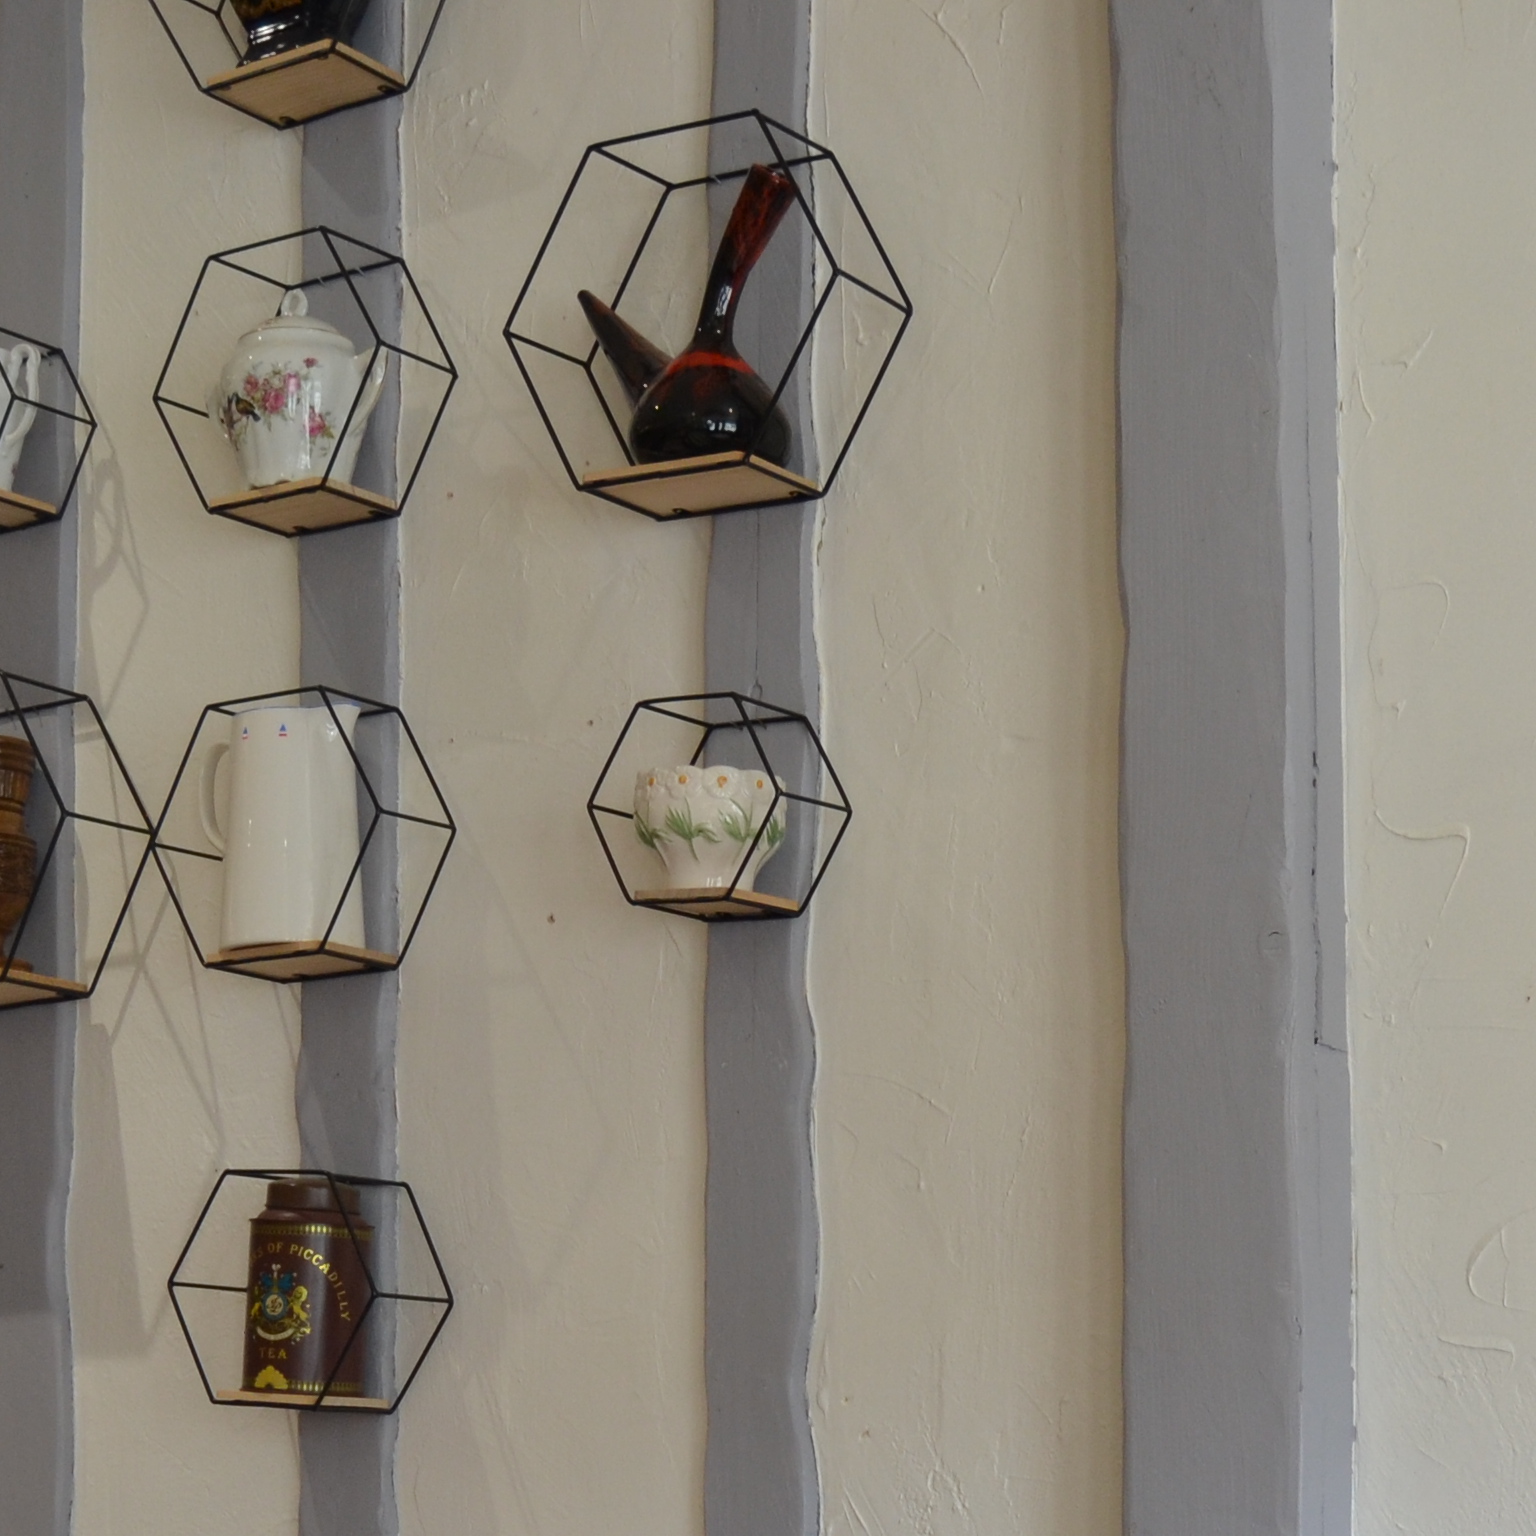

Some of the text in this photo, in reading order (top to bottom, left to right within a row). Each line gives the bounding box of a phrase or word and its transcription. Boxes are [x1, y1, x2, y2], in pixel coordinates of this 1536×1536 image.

[267, 1242, 284, 1254] OF
[290, 1243, 351, 1322] PICCADILLY
[259, 1347, 287, 1359] TEA
